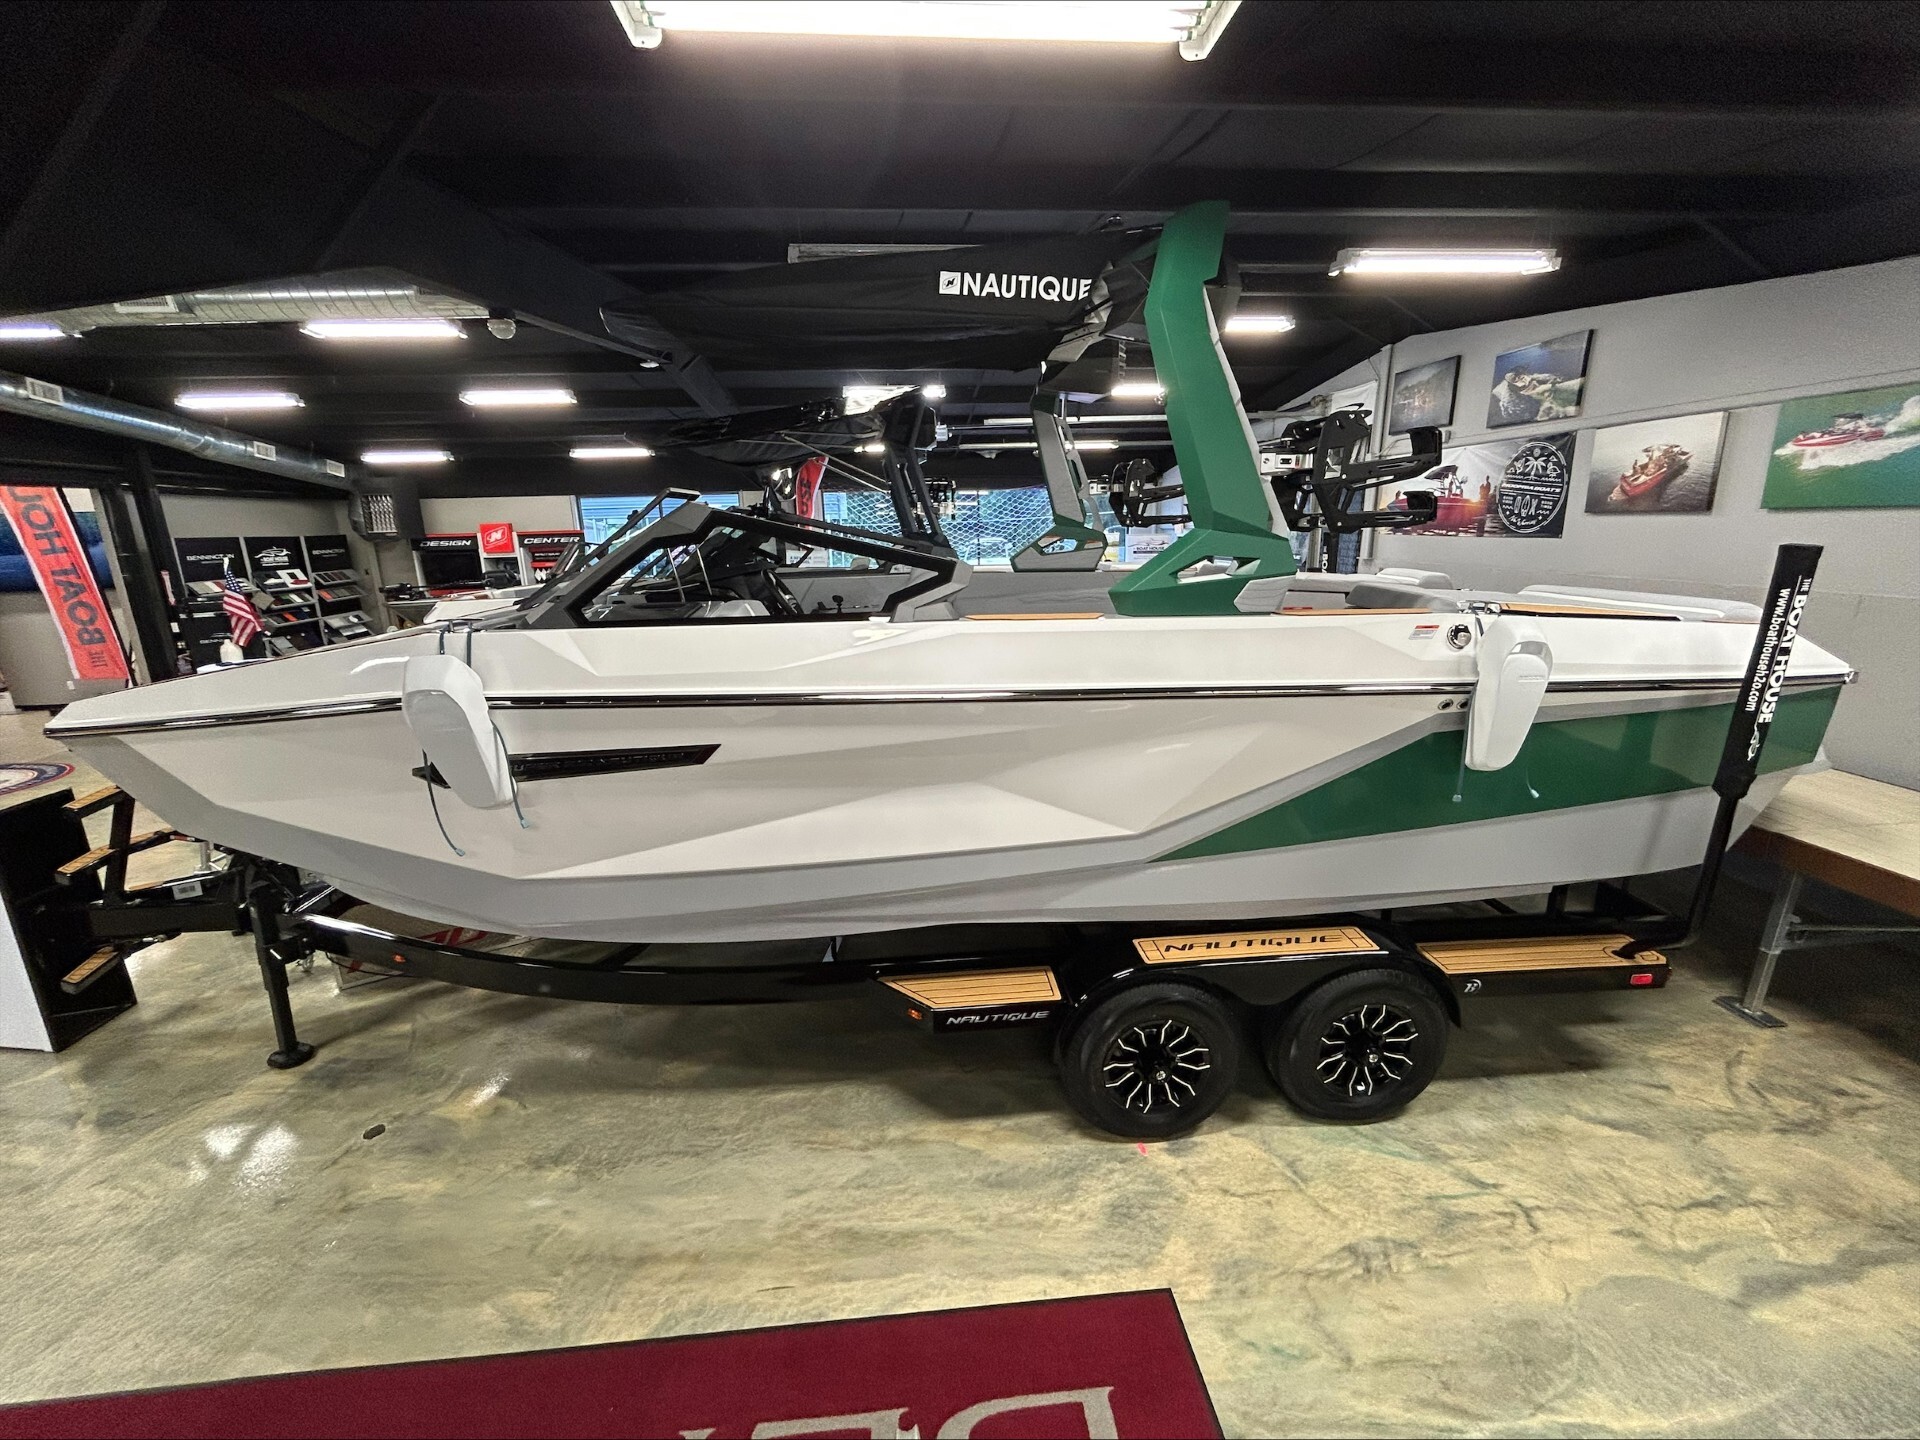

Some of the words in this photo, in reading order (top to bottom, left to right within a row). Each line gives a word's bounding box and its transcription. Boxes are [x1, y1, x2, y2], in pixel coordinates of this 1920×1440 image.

[962, 271, 1093, 302] NAUTIQUE
[524, 536, 580, 545] CENTER
[186, 553, 235, 561] BENNINGTN
[1800, 577, 1812, 592] THE
[1778, 593, 1809, 650] BOAT
[1745, 587, 1791, 712] www.boathouseh2o.com
[1758, 653, 1789, 724] HOUSE
[1163, 935, 1343, 953] NAUTIQUE
[946, 1010, 1051, 1025] NAUTIQUE
